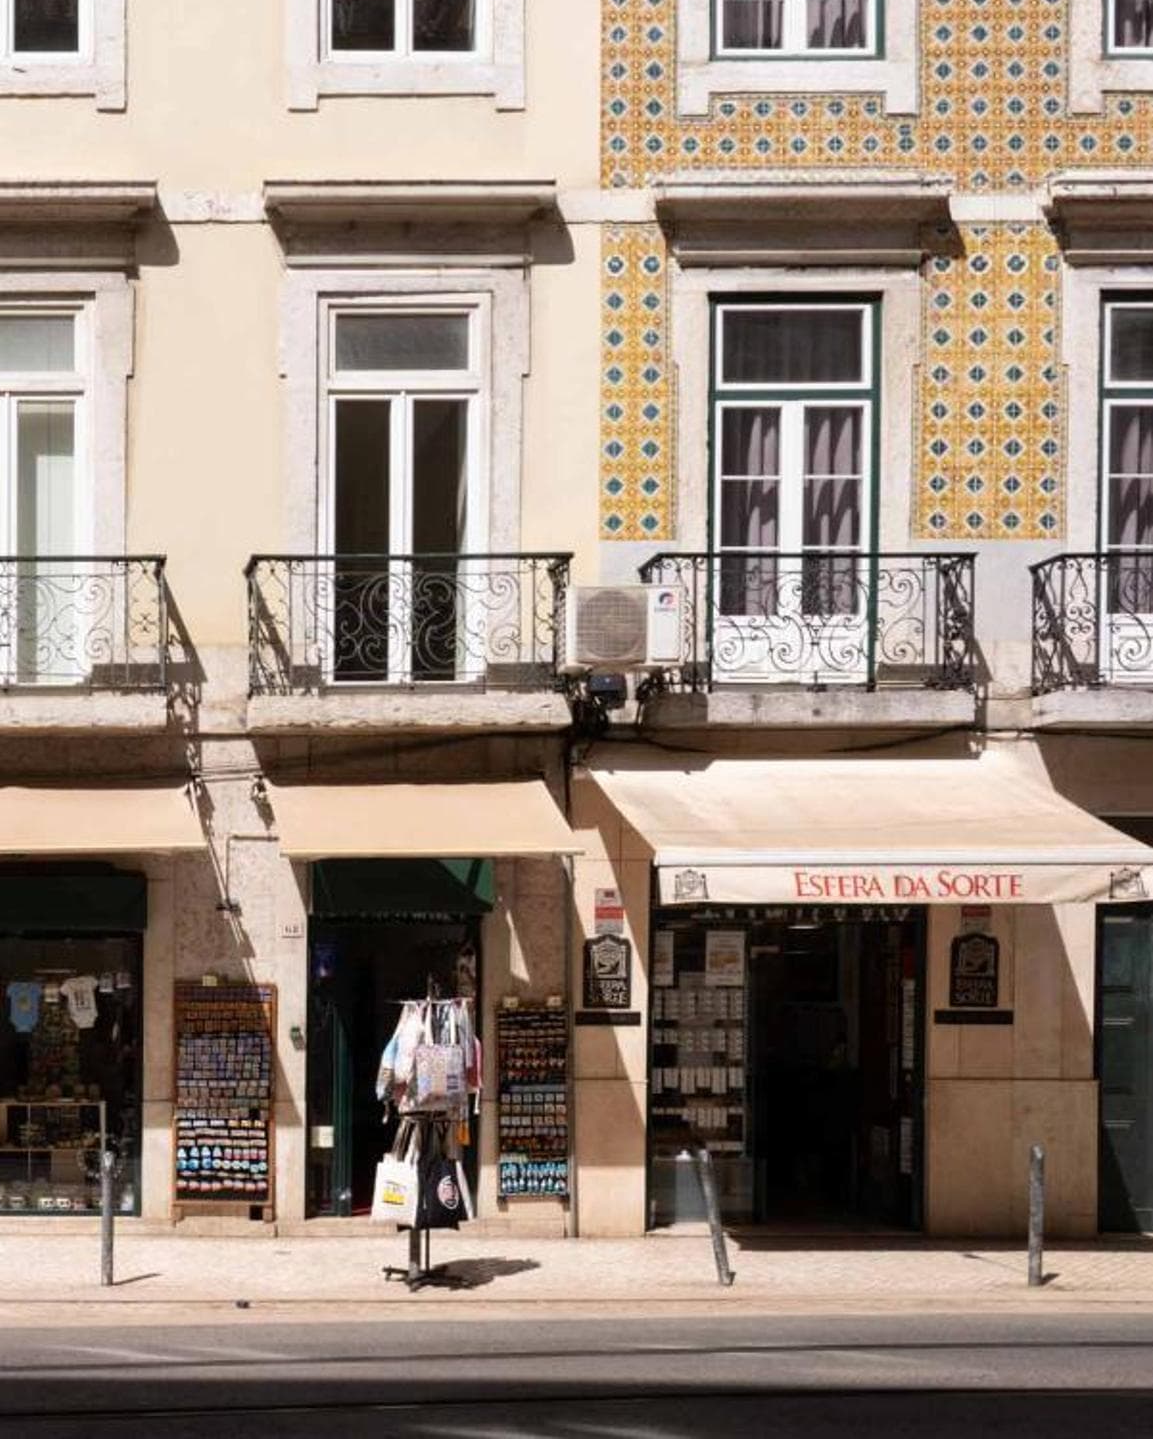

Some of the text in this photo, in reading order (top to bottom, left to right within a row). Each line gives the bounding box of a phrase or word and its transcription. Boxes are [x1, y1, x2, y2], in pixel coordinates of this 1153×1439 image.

[794, 870, 1024, 898] ESFERA DA SORTE
